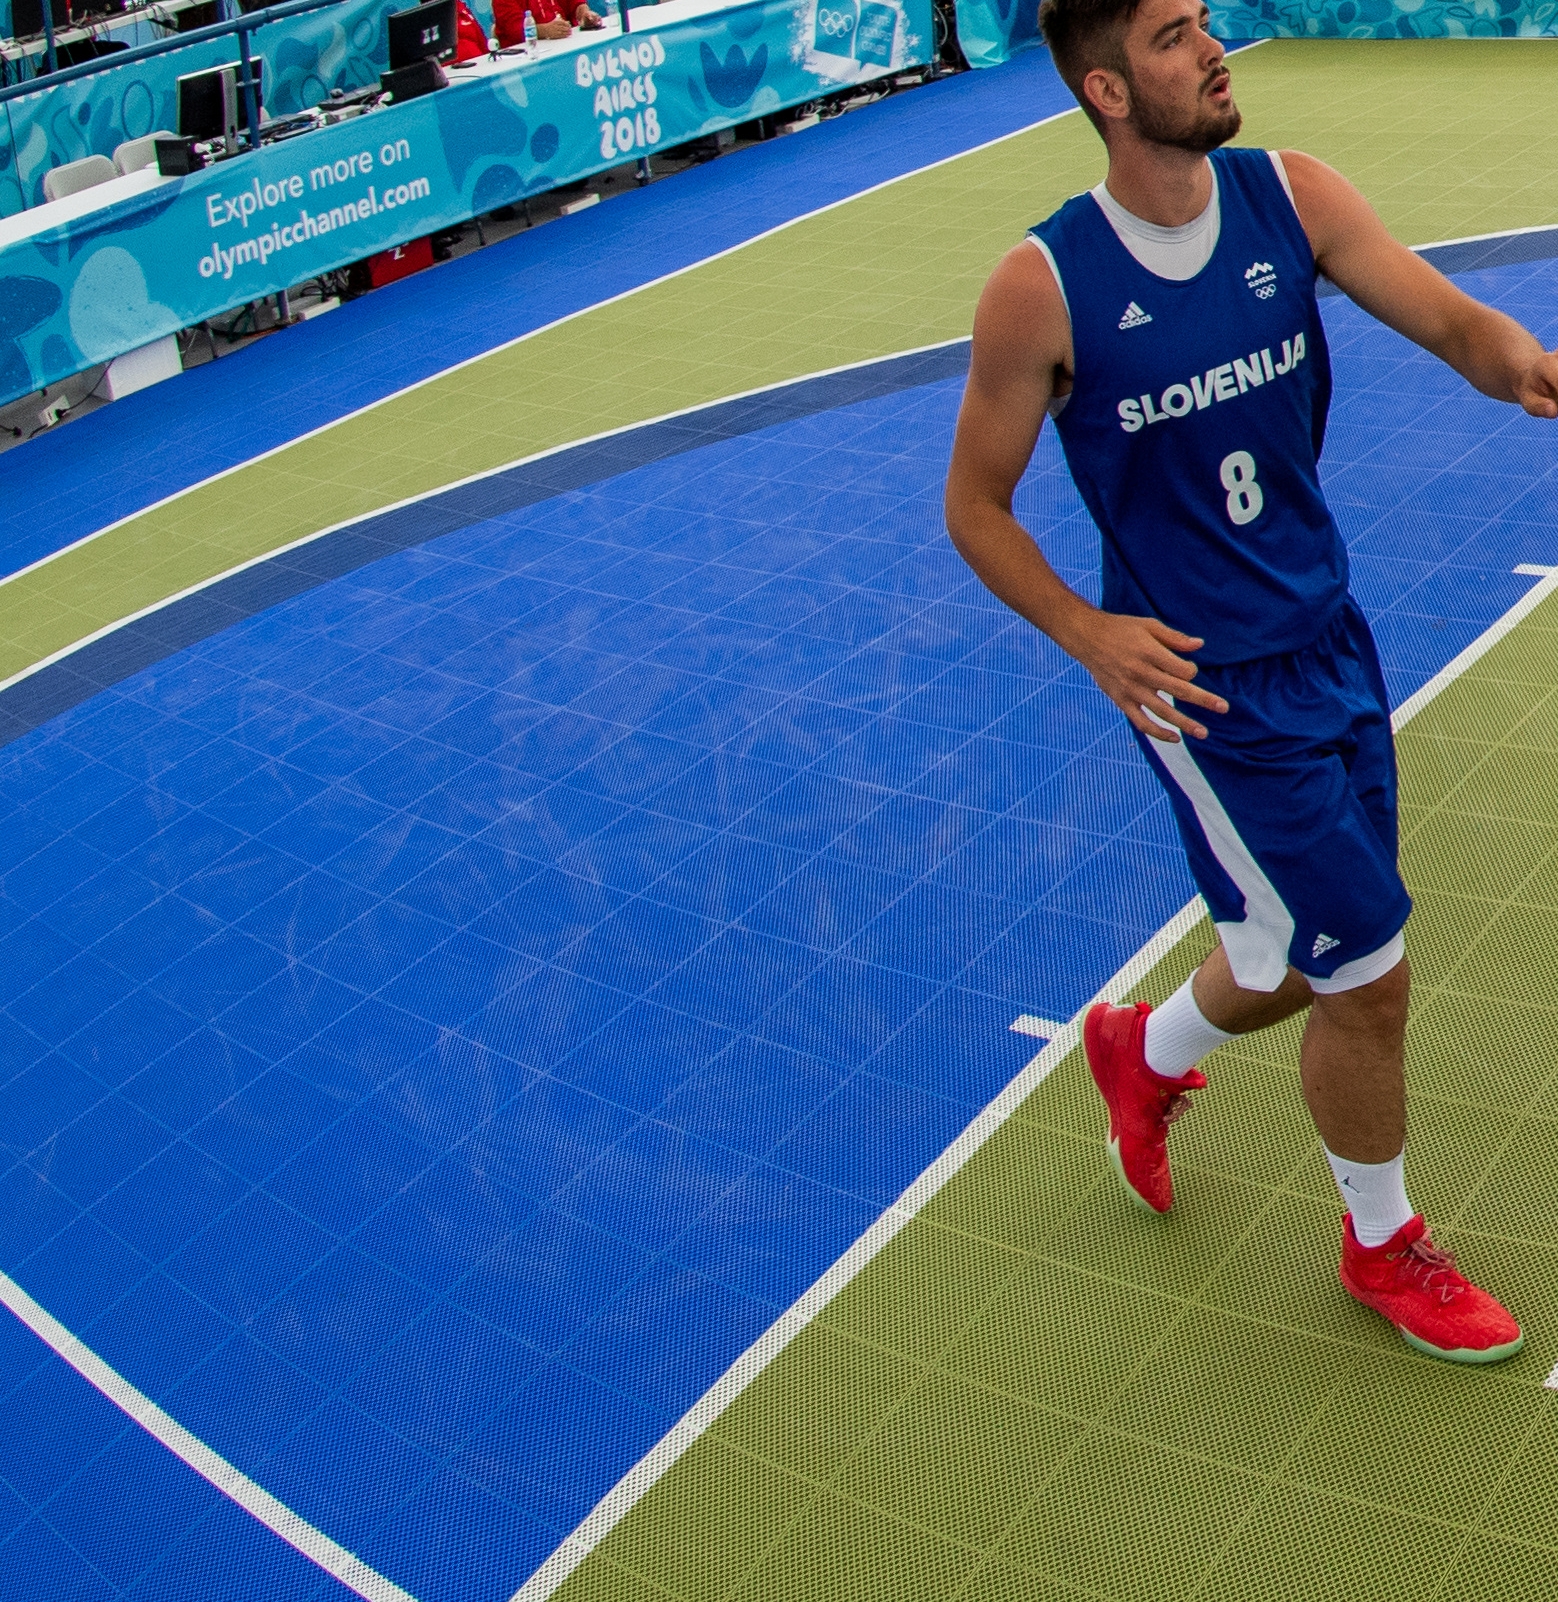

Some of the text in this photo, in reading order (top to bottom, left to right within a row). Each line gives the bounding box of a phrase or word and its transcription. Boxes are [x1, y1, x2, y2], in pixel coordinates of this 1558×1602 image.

[575, 34, 666, 88] BUENOS
[593, 71, 658, 119] AIRES
[599, 106, 662, 160] 2018
[205, 138, 411, 228] Explore more on
[198, 176, 432, 280] olympicchannel.com
[1118, 314, 1153, 330] adidas
[1117, 331, 1306, 433] SLOVENIJA
[1219, 450, 1264, 526] 8
